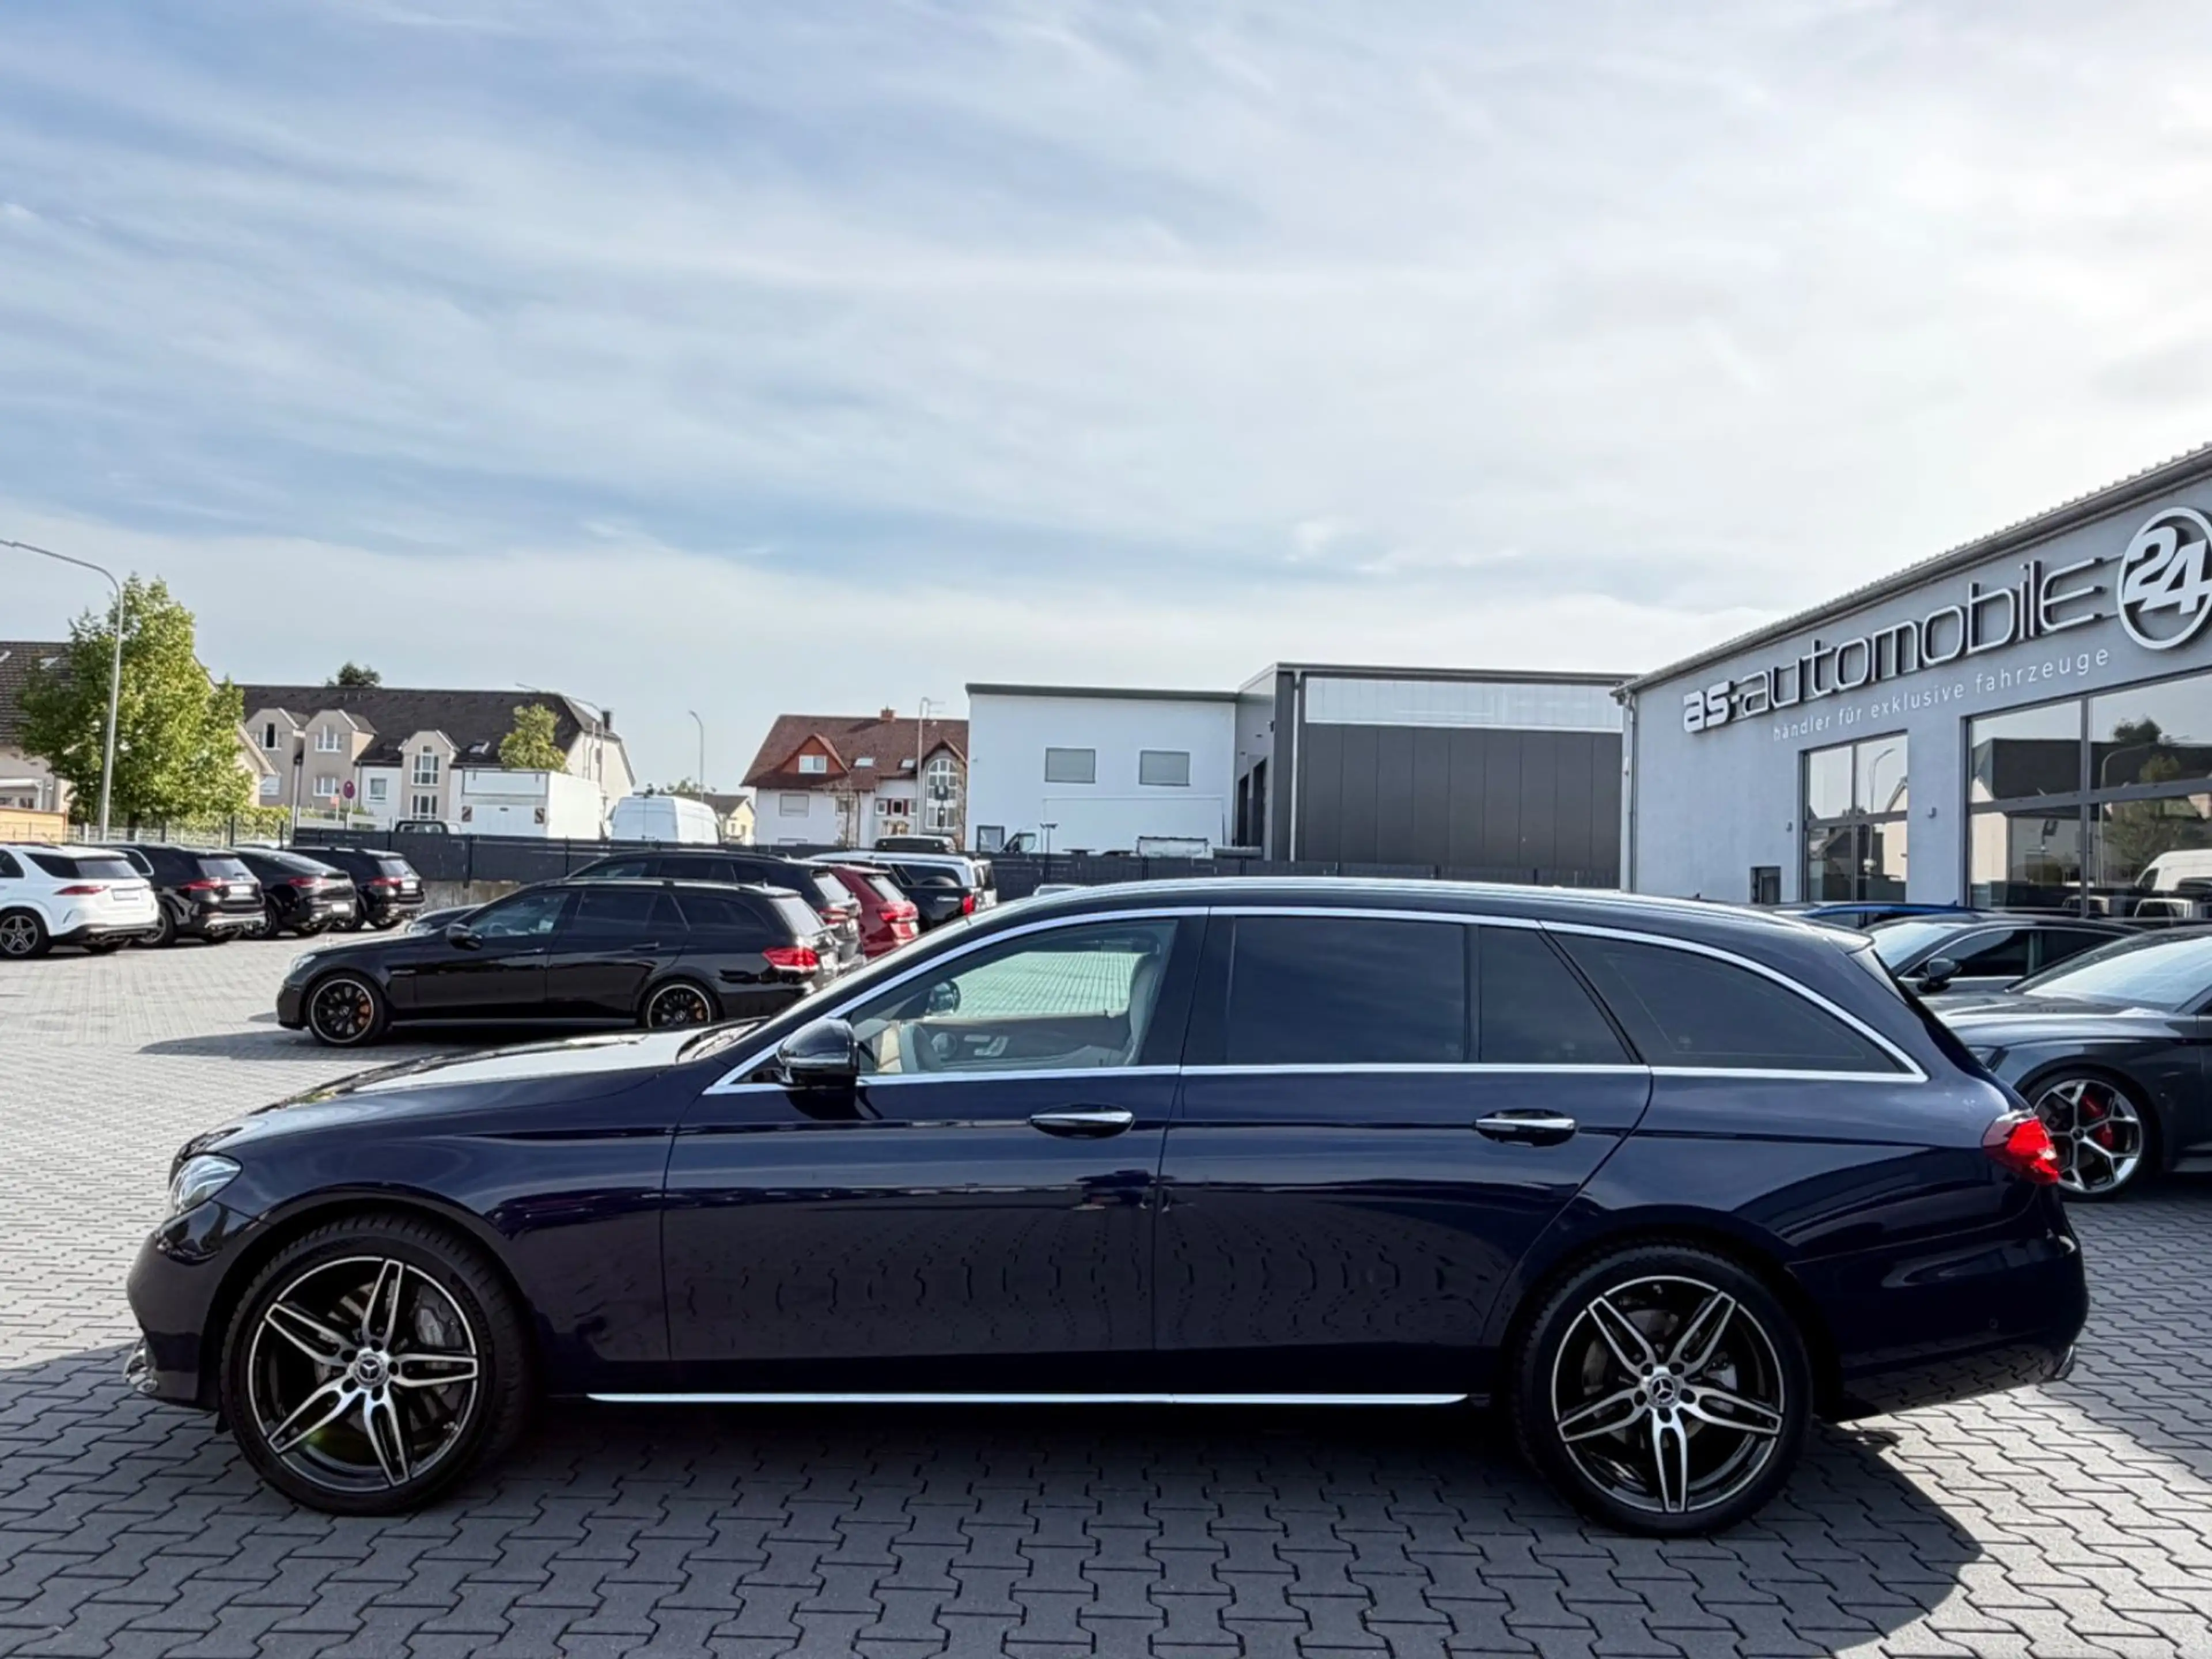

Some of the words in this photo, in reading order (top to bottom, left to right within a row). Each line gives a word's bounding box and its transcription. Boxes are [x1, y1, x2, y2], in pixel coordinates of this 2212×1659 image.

[2123, 526, 2212, 615] 24
[1773, 714, 1830, 741] händler
[1838, 706, 1862, 726] für
[1871, 683, 1964, 718] exklusive
[1976, 648, 2109, 692] fahrzeuge
